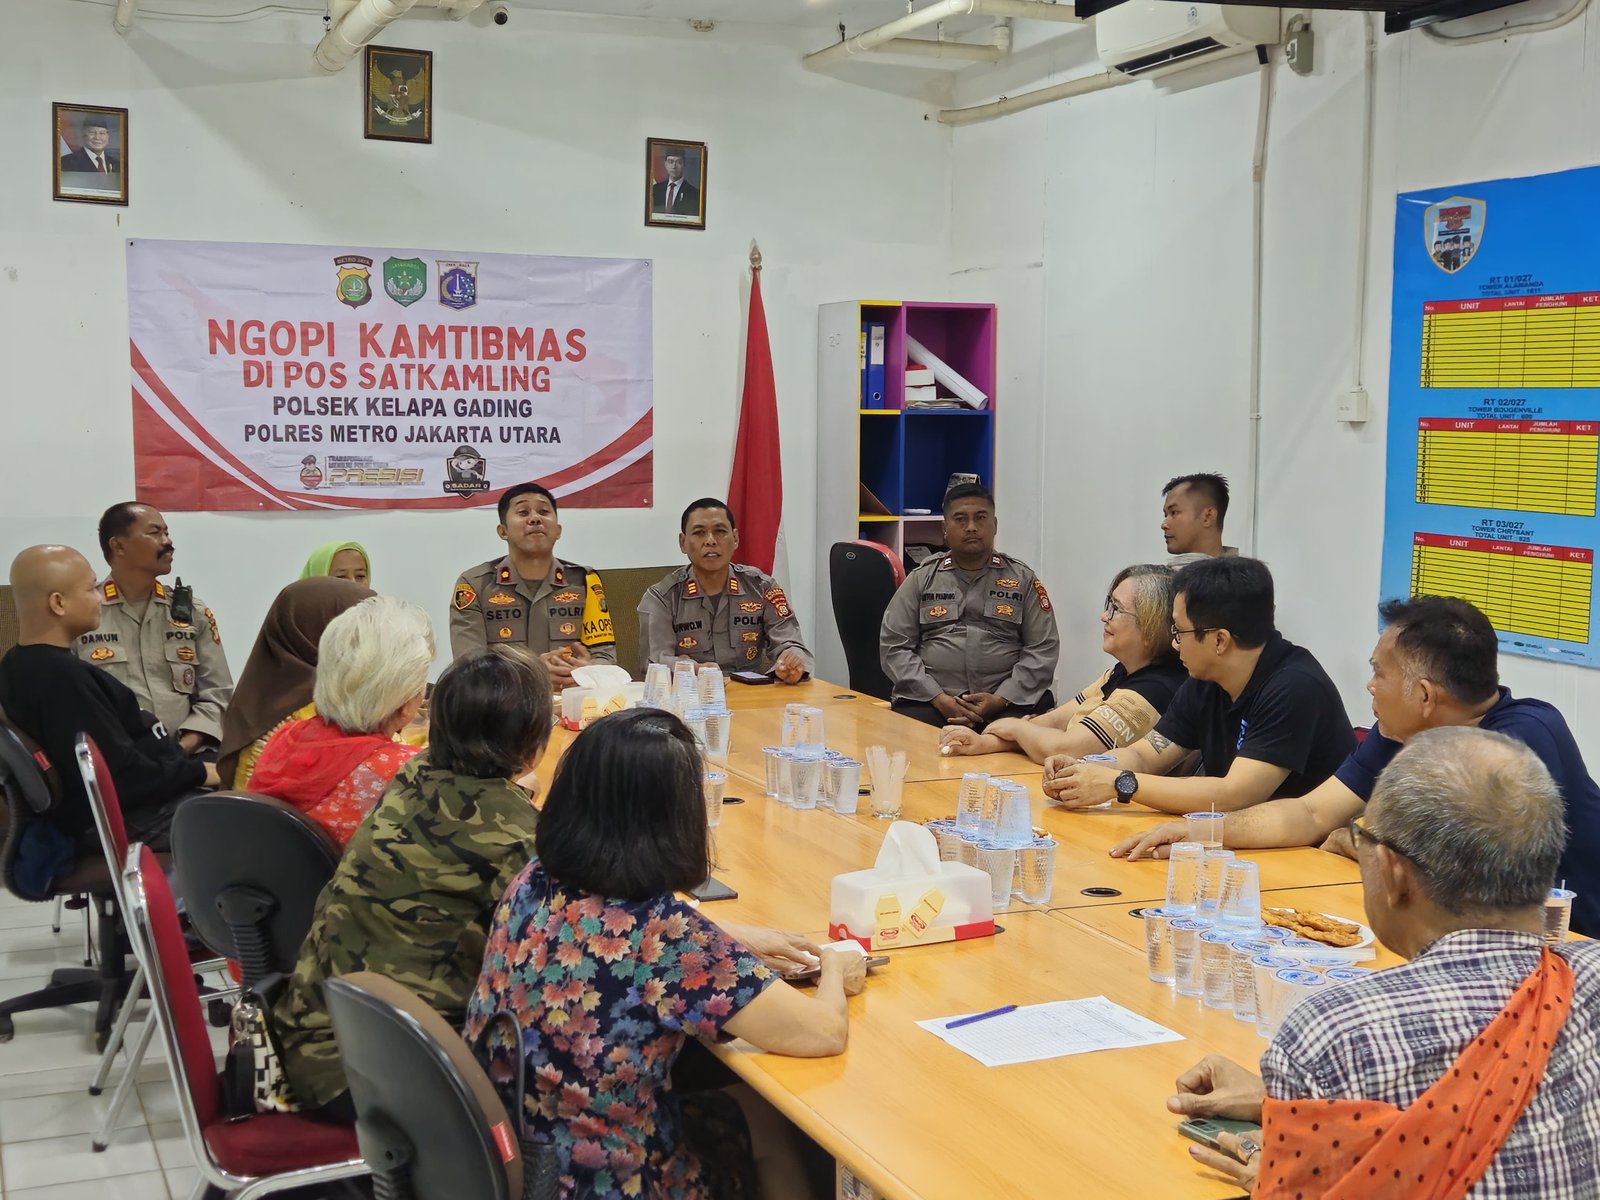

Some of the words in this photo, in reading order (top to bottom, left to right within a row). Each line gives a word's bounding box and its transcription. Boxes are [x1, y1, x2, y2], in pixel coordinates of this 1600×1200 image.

[208, 319, 335, 356] NGOPI
[359, 322, 586, 362] KAMTIBMAS
[243, 360, 272, 388] DI
[284, 361, 347, 389] POS
[358, 362, 550, 392] SATKAMLING
[273, 396, 359, 416] POLSEK
[366, 397, 447, 417] KELAPA
[454, 398, 532, 418] GADING
[244, 424, 323, 442] POLRES
[330, 424, 398, 442] METRO
[404, 426, 493, 443] JAKARTA
[500, 426, 561, 444] UTARA
[330, 468, 424, 482] PRESISI
[1496, 521, 1524, 529] 03/027
[1496, 528, 1535, 536] CHRYSANT
[990, 590, 1022, 601] POLRI
[486, 608, 522, 620] SETO
[583, 621, 598, 635] KA
[81, 634, 118, 645] DAMUN
